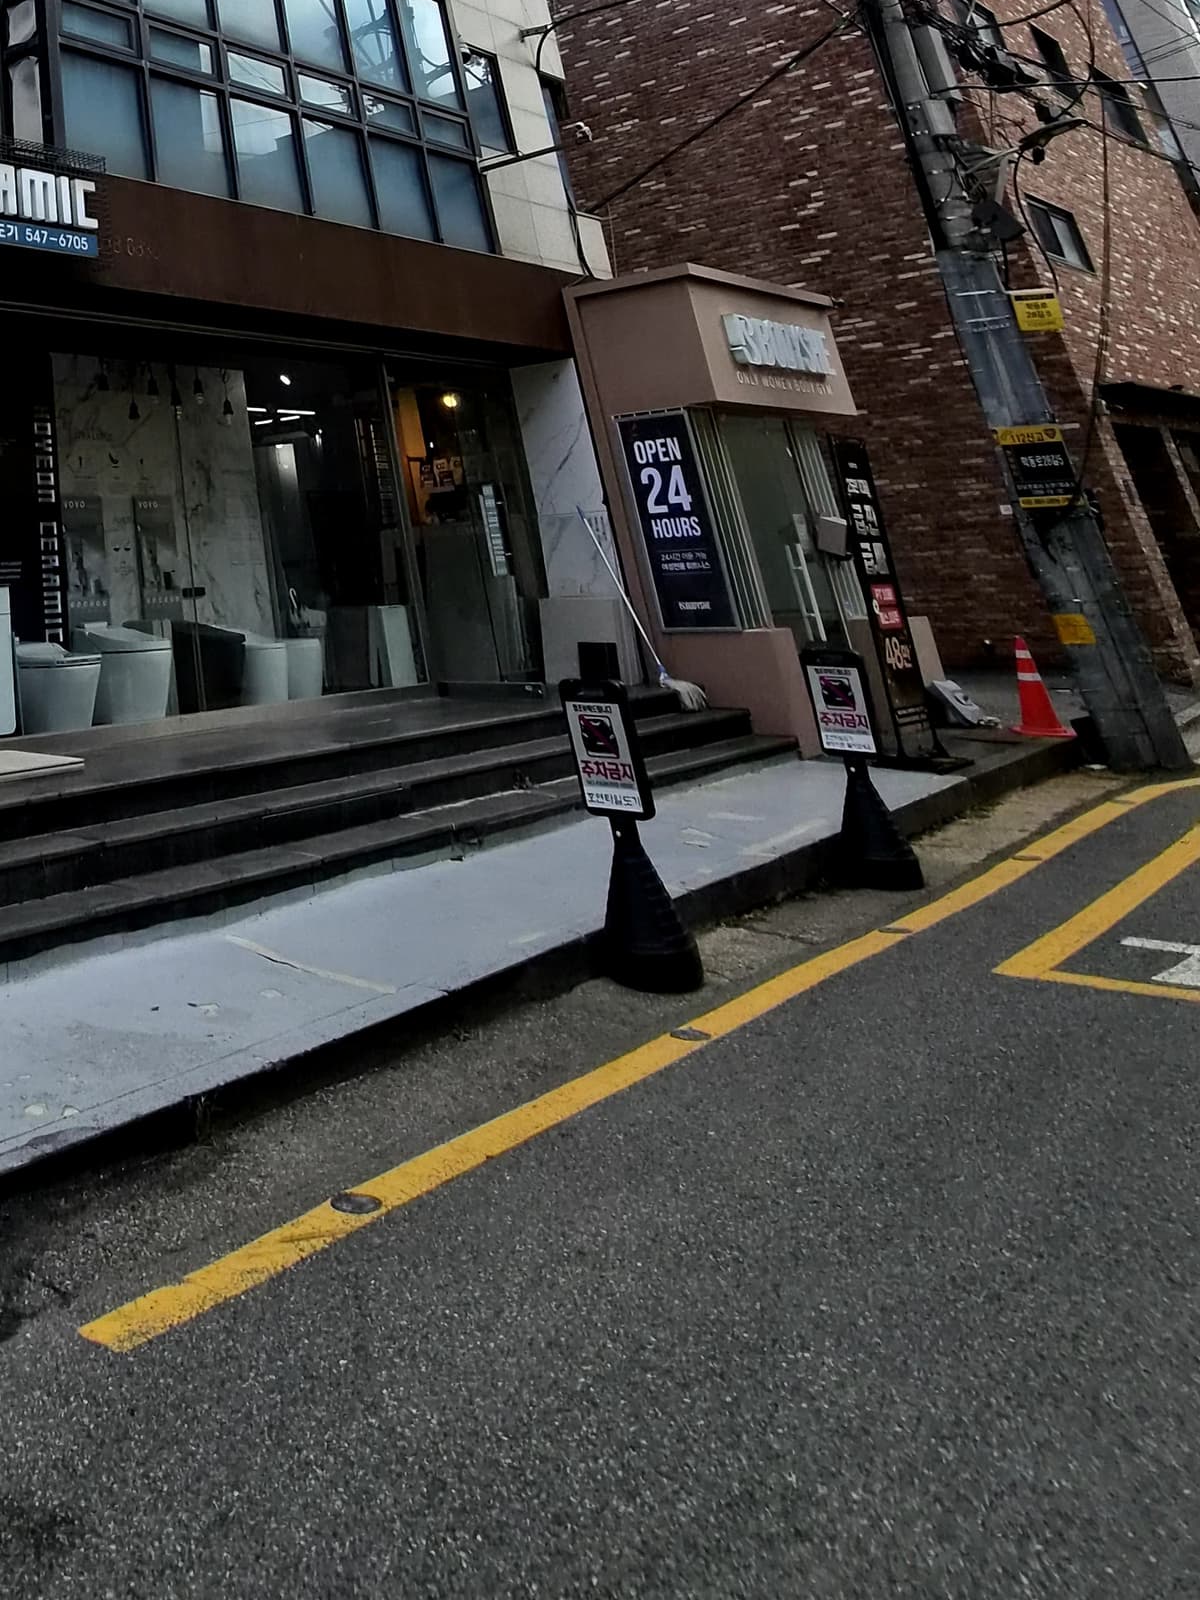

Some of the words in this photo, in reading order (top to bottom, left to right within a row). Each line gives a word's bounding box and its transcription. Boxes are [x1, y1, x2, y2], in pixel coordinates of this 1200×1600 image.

[25, 227, 90, 252] 547-6705
[736, 370, 759, 386] ONLY
[761, 375, 793, 390] WOMEN
[633, 436, 683, 465] OPEN
[640, 464, 693, 514] 24
[650, 516, 703, 540] HOURS
[819, 711, 869, 729] 주차금지
[581, 759, 635, 781] 주차금지
